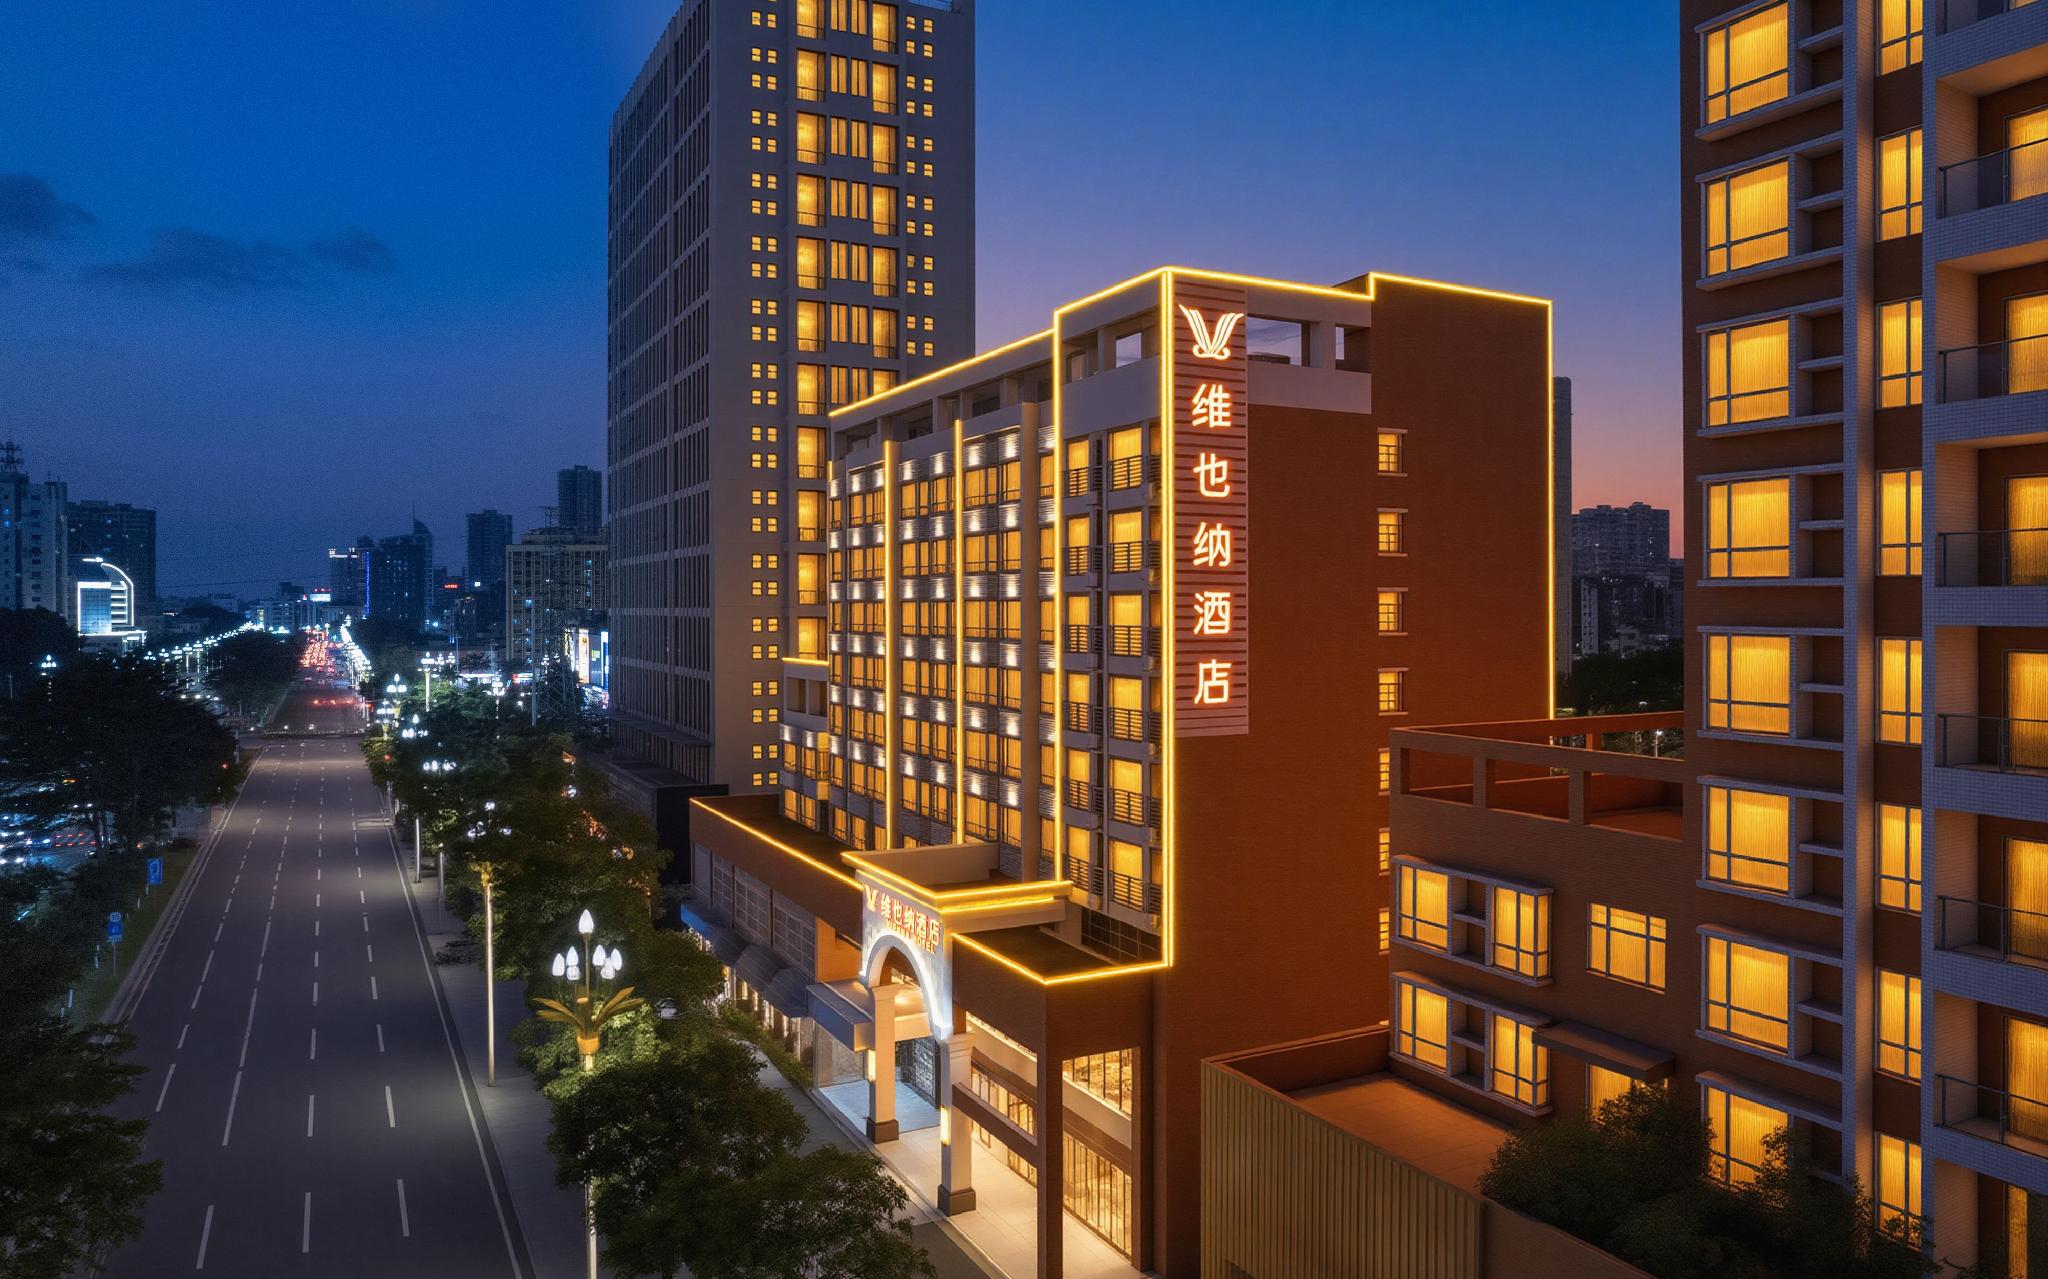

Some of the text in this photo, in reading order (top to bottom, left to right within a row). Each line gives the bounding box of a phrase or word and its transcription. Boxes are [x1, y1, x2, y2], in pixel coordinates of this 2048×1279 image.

[1191, 384, 1231, 705] 维也纳酒店
[881, 893, 940, 946] 维也纳酒店
